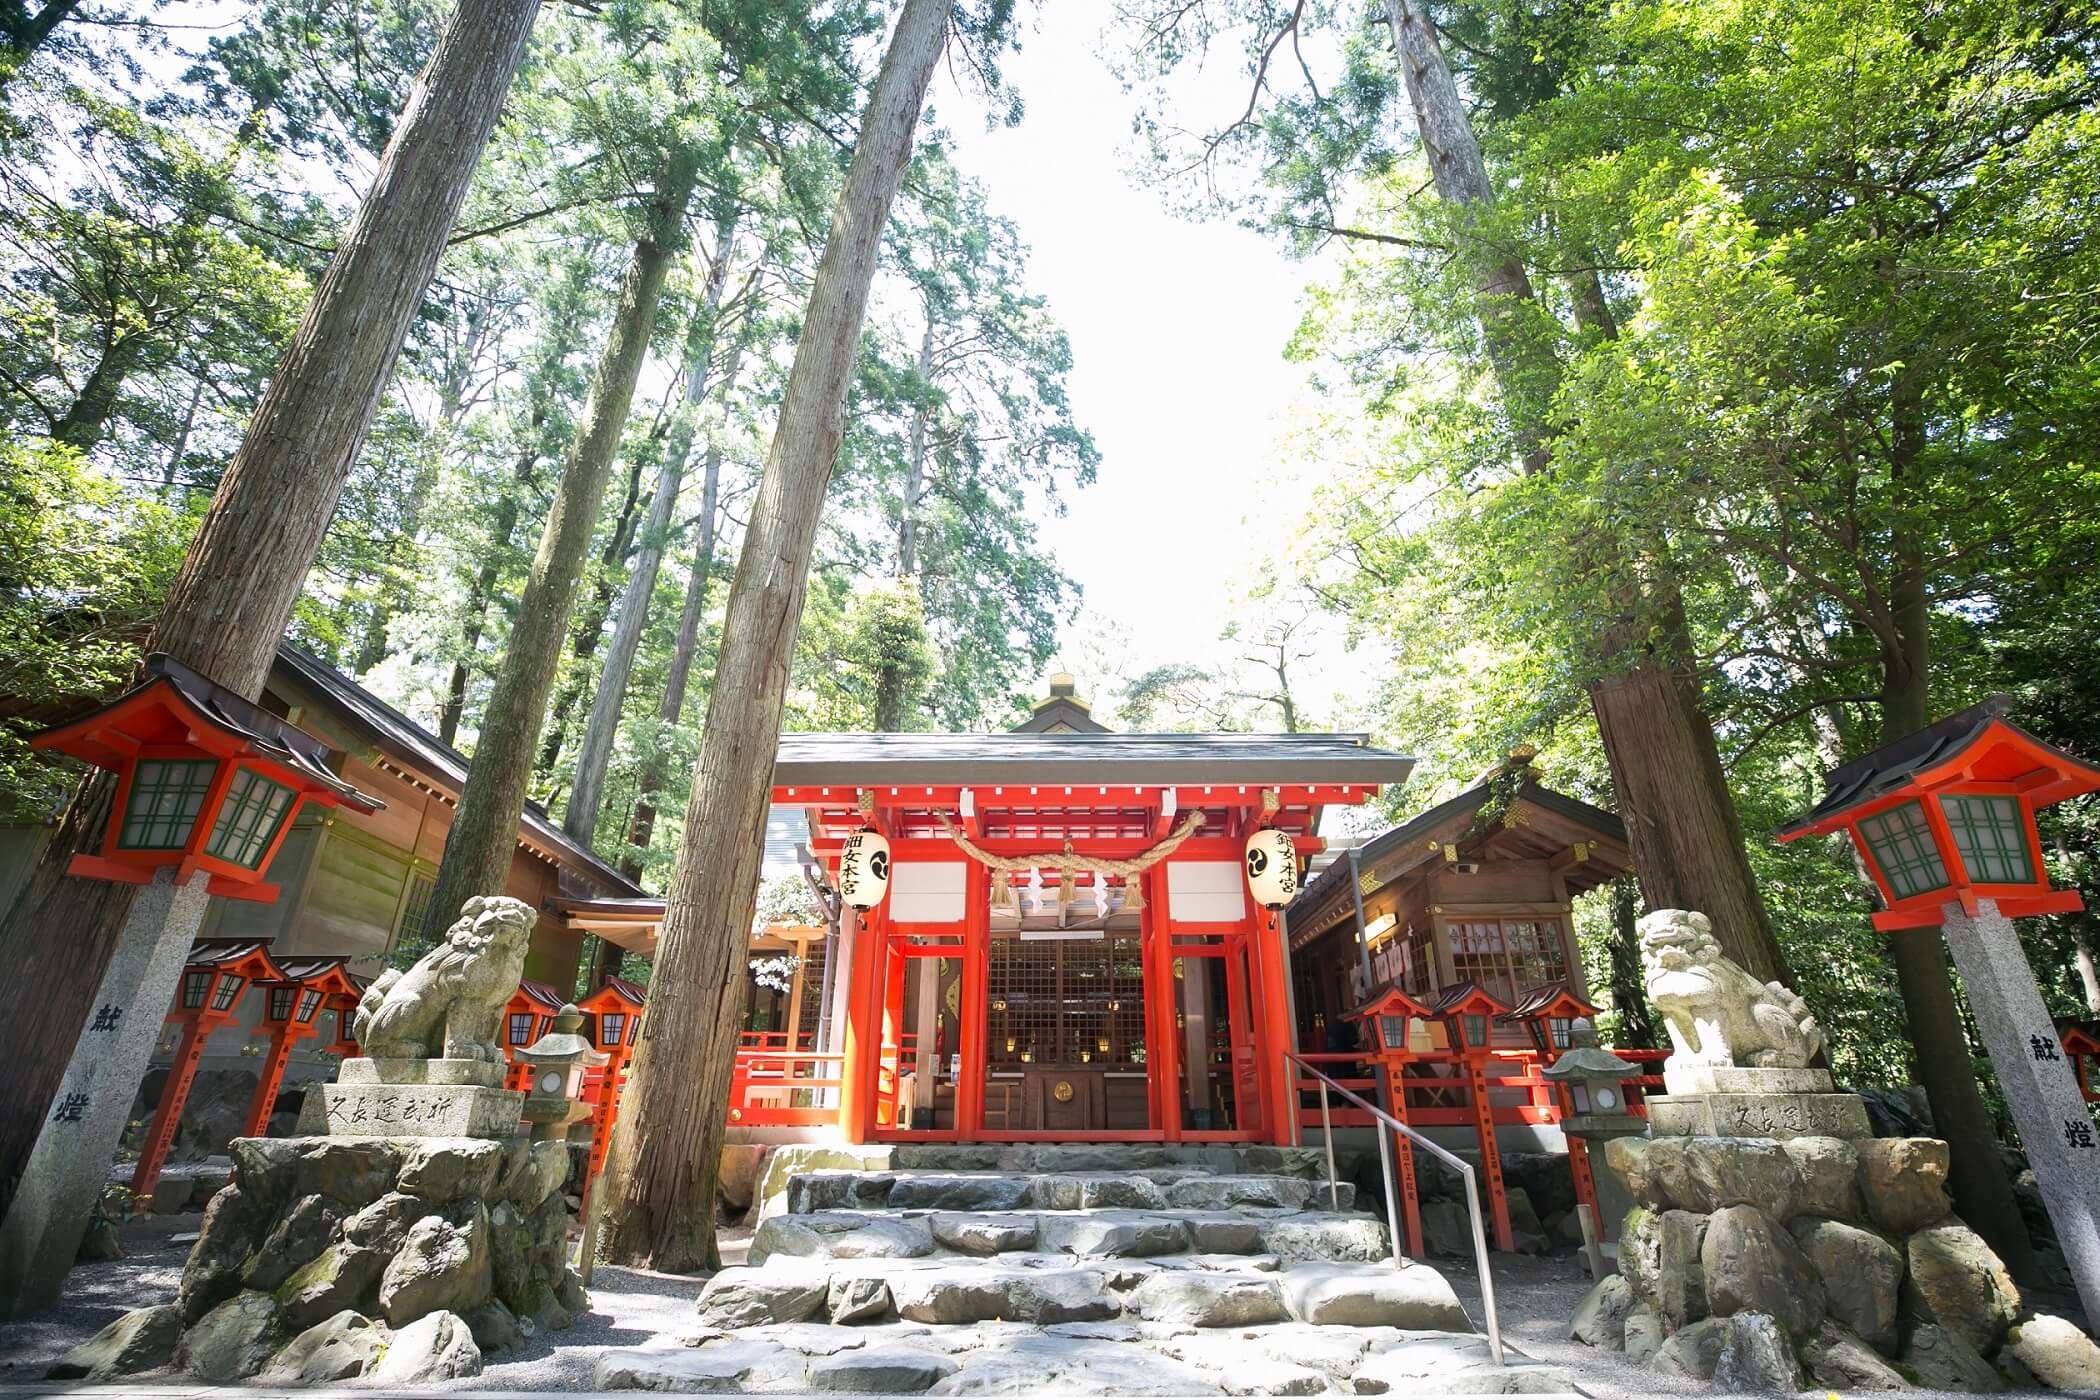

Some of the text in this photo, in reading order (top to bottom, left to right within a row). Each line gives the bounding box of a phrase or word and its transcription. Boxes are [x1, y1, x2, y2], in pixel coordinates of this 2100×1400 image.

[1275, 833, 1296, 893] 鈿女本宮
[53, 1003, 123, 1122] 献燈
[2029, 1033, 2096, 1148] 献燈
